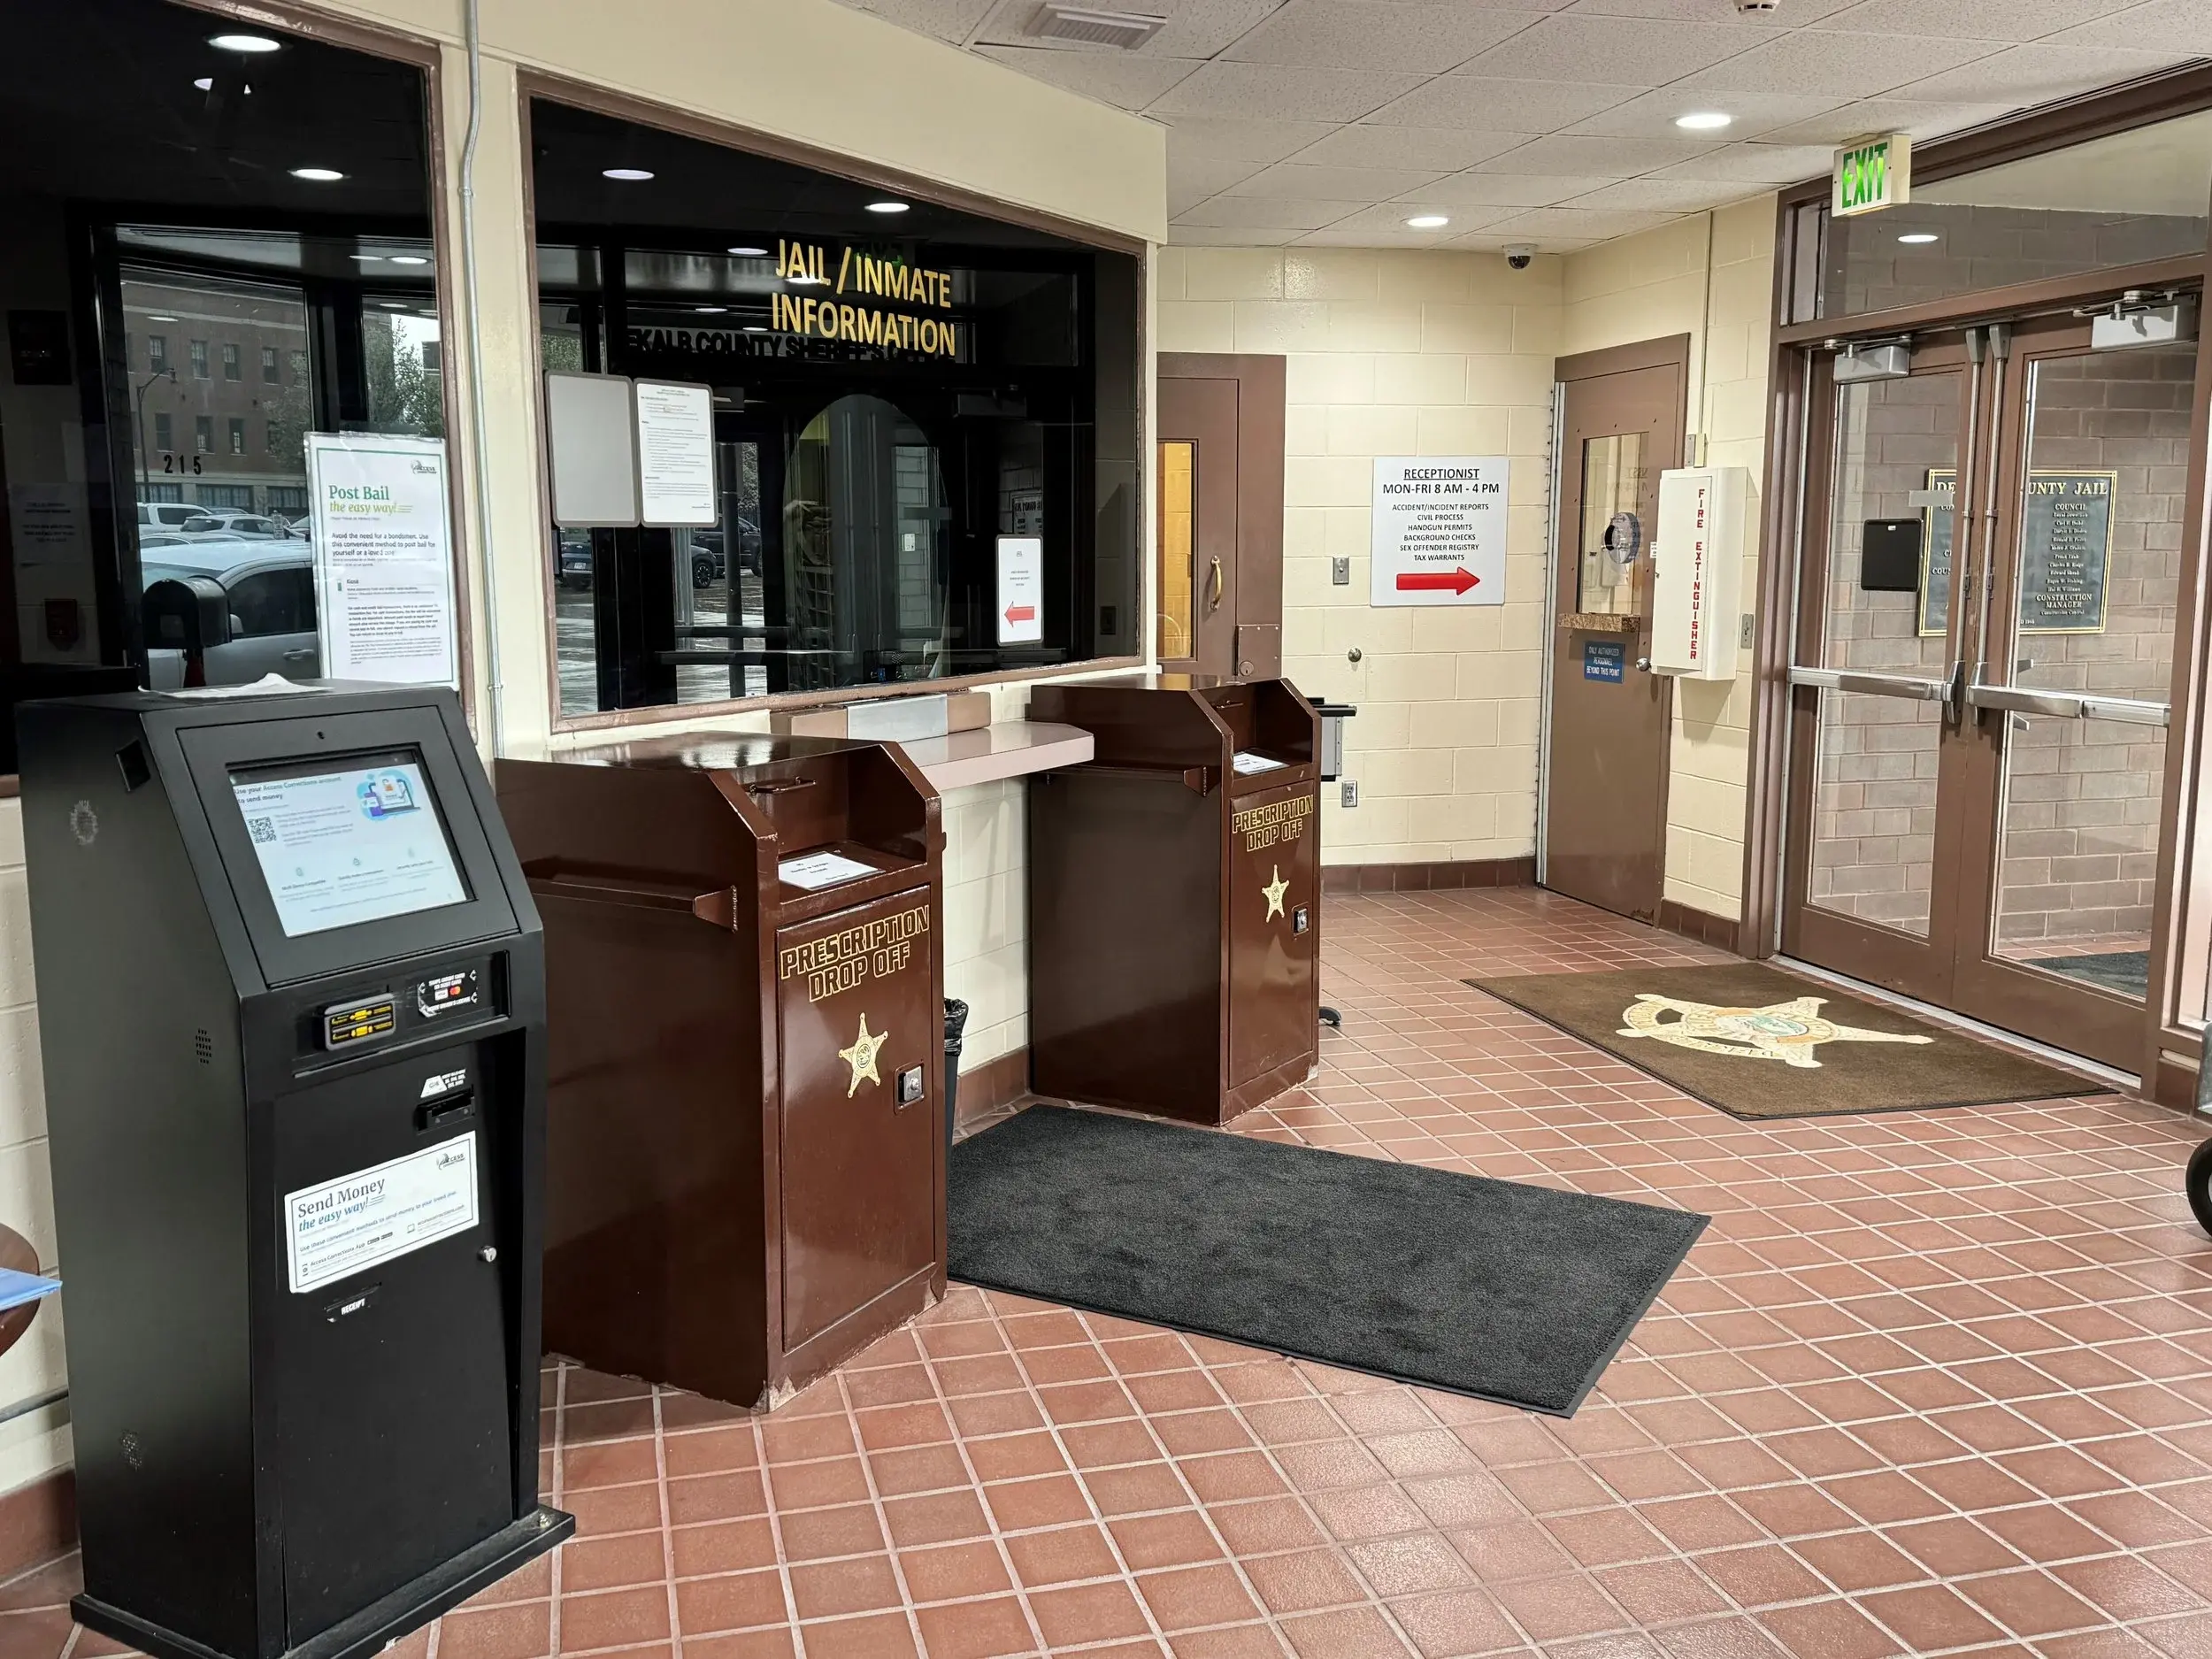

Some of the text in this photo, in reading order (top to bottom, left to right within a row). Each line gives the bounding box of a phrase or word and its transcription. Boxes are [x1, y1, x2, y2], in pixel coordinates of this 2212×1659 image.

[1842, 142, 1887, 208] EXIT
[776, 239, 831, 286] JAIL
[772, 292, 956, 356] INFORMATION
[695, 332, 781, 357] COUNTY
[1383, 484, 1431, 494] MON-FRI
[1434, 484, 1440, 494] 8
[1444, 484, 1463, 494] AM
[1472, 483, 1479, 493] 4
[1482, 483, 1499, 493] PM
[1403, 468, 1480, 480] RECEPTIONIST
[2028, 481, 2108, 495] UNTY JAIL
[328, 485, 389, 500] Post Bail
[330, 501, 396, 516] the easy way!
[1690, 541, 1702, 660] EXTINGUISHER
[1609, 668, 1619, 677] POINT
[248, 786, 262, 795] your
[262, 793, 283, 802] money
[1232, 795, 1313, 833] PRESCRIPTION
[1247, 818, 1302, 852] DROP OFF
[780, 904, 929, 979] PRESCRIPTION
[809, 941, 910, 1002] DROP OFF
[297, 1179, 385, 1218] Send Money
[298, 1197, 369, 1232] the easy way!
[311, 1240, 326, 1248] these
[326, 1229, 355, 1242] convenient
[386, 1213, 397, 1223] send
[398, 1207, 415, 1217] money
[422, 1200, 433, 1209] your
[310, 1256, 326, 1266] Access
[326, 1246, 355, 1260] Corrections
[341, 1297, 365, 1316] RECEIPT
